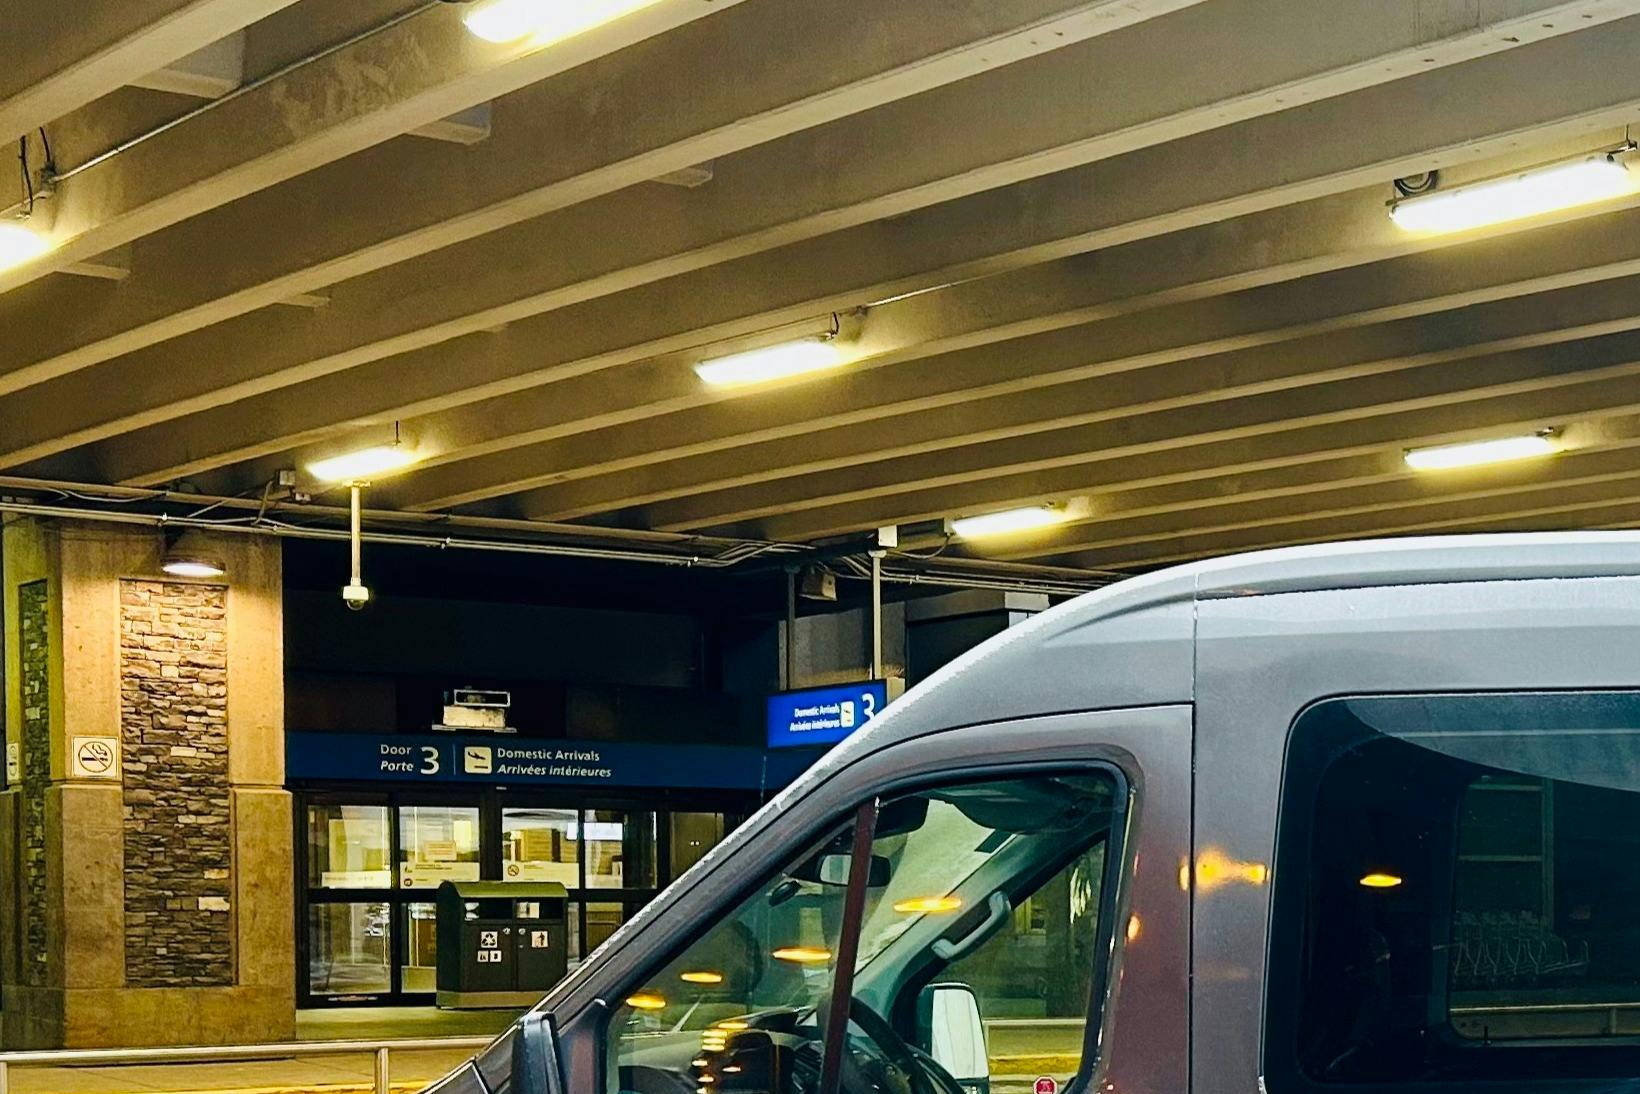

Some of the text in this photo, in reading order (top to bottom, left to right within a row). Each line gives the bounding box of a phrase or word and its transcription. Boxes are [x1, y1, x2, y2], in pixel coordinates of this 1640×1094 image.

[861, 693, 875, 721] 3
[380, 744, 411, 755] Door
[497, 748, 600, 762] Domestic Arrivals
[380, 761, 414, 772] Porte
[420, 746, 440, 774] 3
[497, 764, 612, 778] Arrivées intérieures
